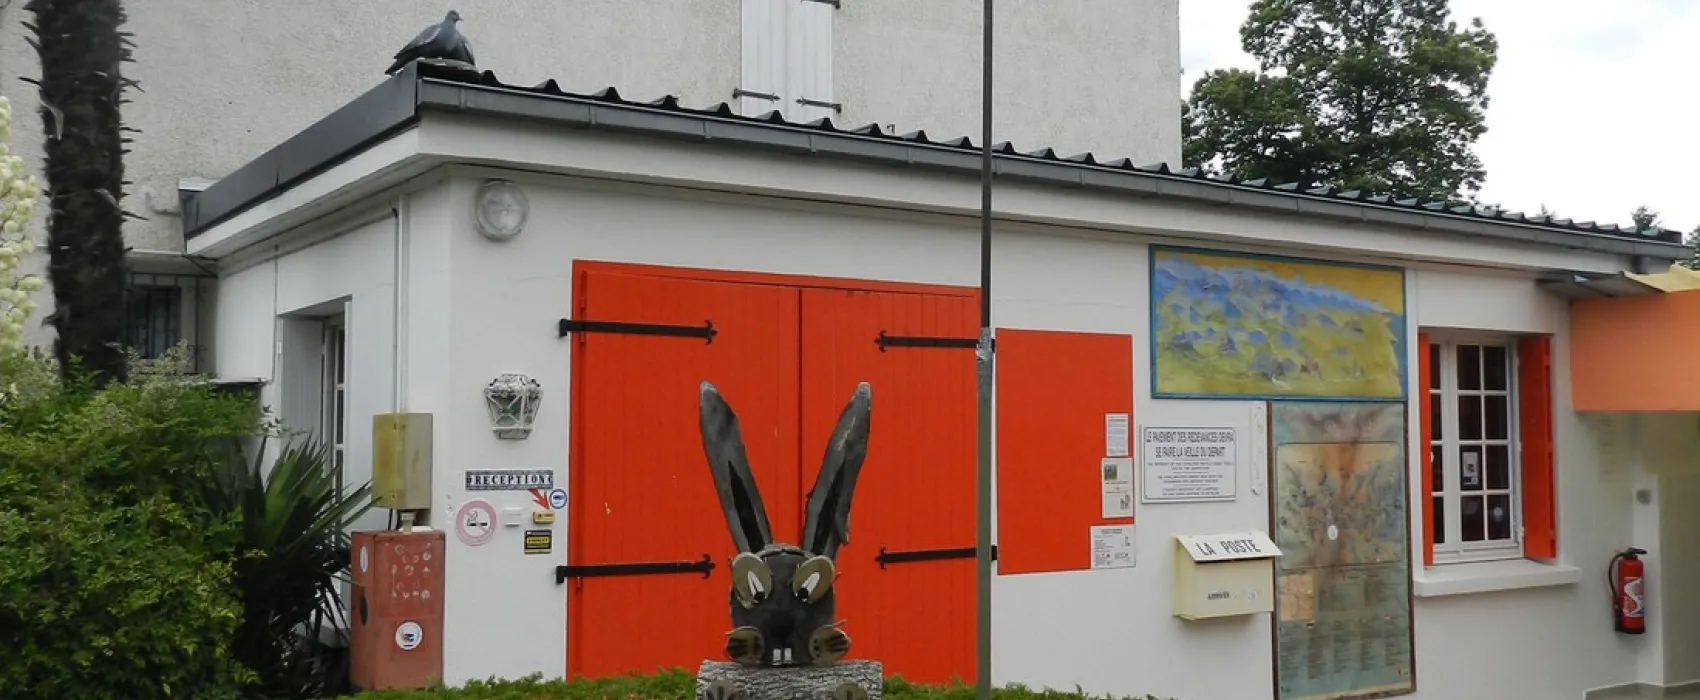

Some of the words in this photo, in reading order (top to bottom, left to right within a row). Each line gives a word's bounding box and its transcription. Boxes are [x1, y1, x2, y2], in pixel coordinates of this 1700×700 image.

[475, 474, 546, 486] RECEPTION
[1195, 542, 1217, 556] LA
[1220, 539, 1262, 555] POSTE
